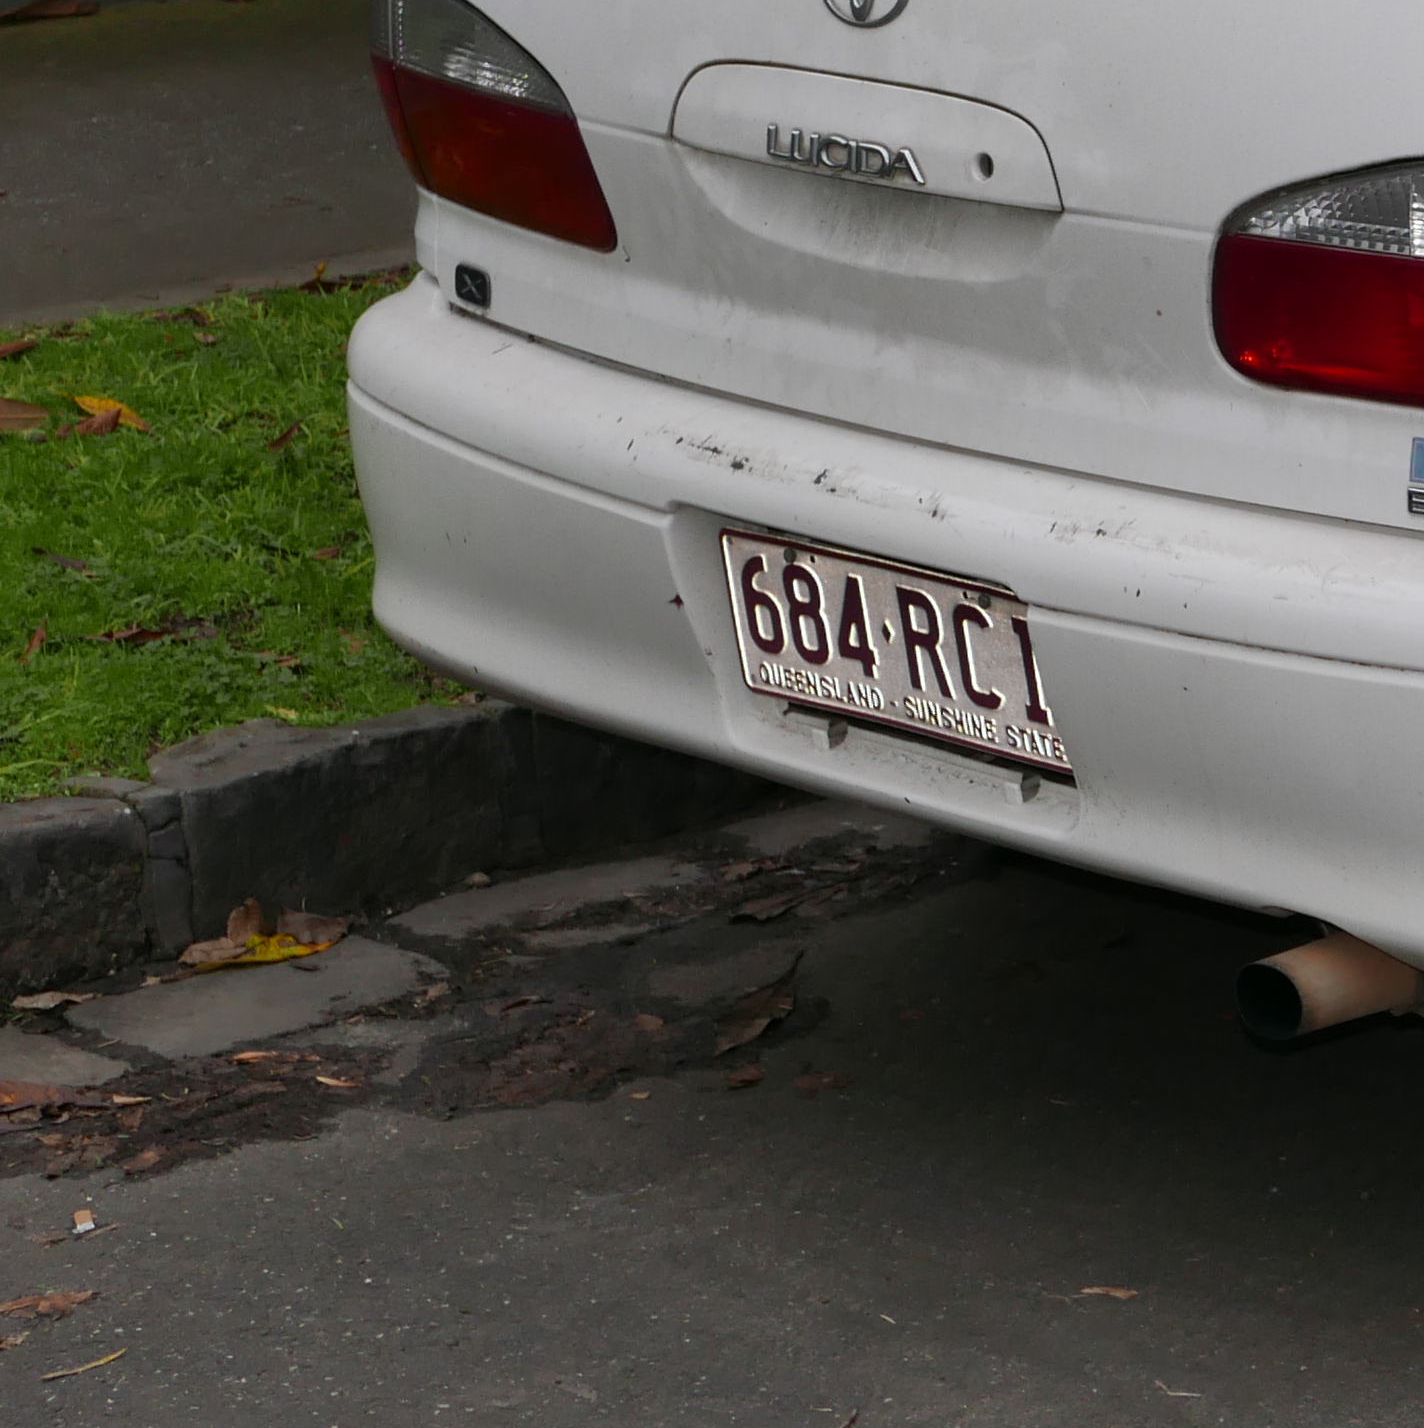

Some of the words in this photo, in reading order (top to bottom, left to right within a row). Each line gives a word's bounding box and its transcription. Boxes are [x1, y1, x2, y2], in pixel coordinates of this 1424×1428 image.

[767, 123, 925, 185] LUCIDA
[760, 661, 885, 711] QUEENSLAND
[904, 695, 999, 743] SUNSHINE
[1006, 725, 1068, 762] STATE
